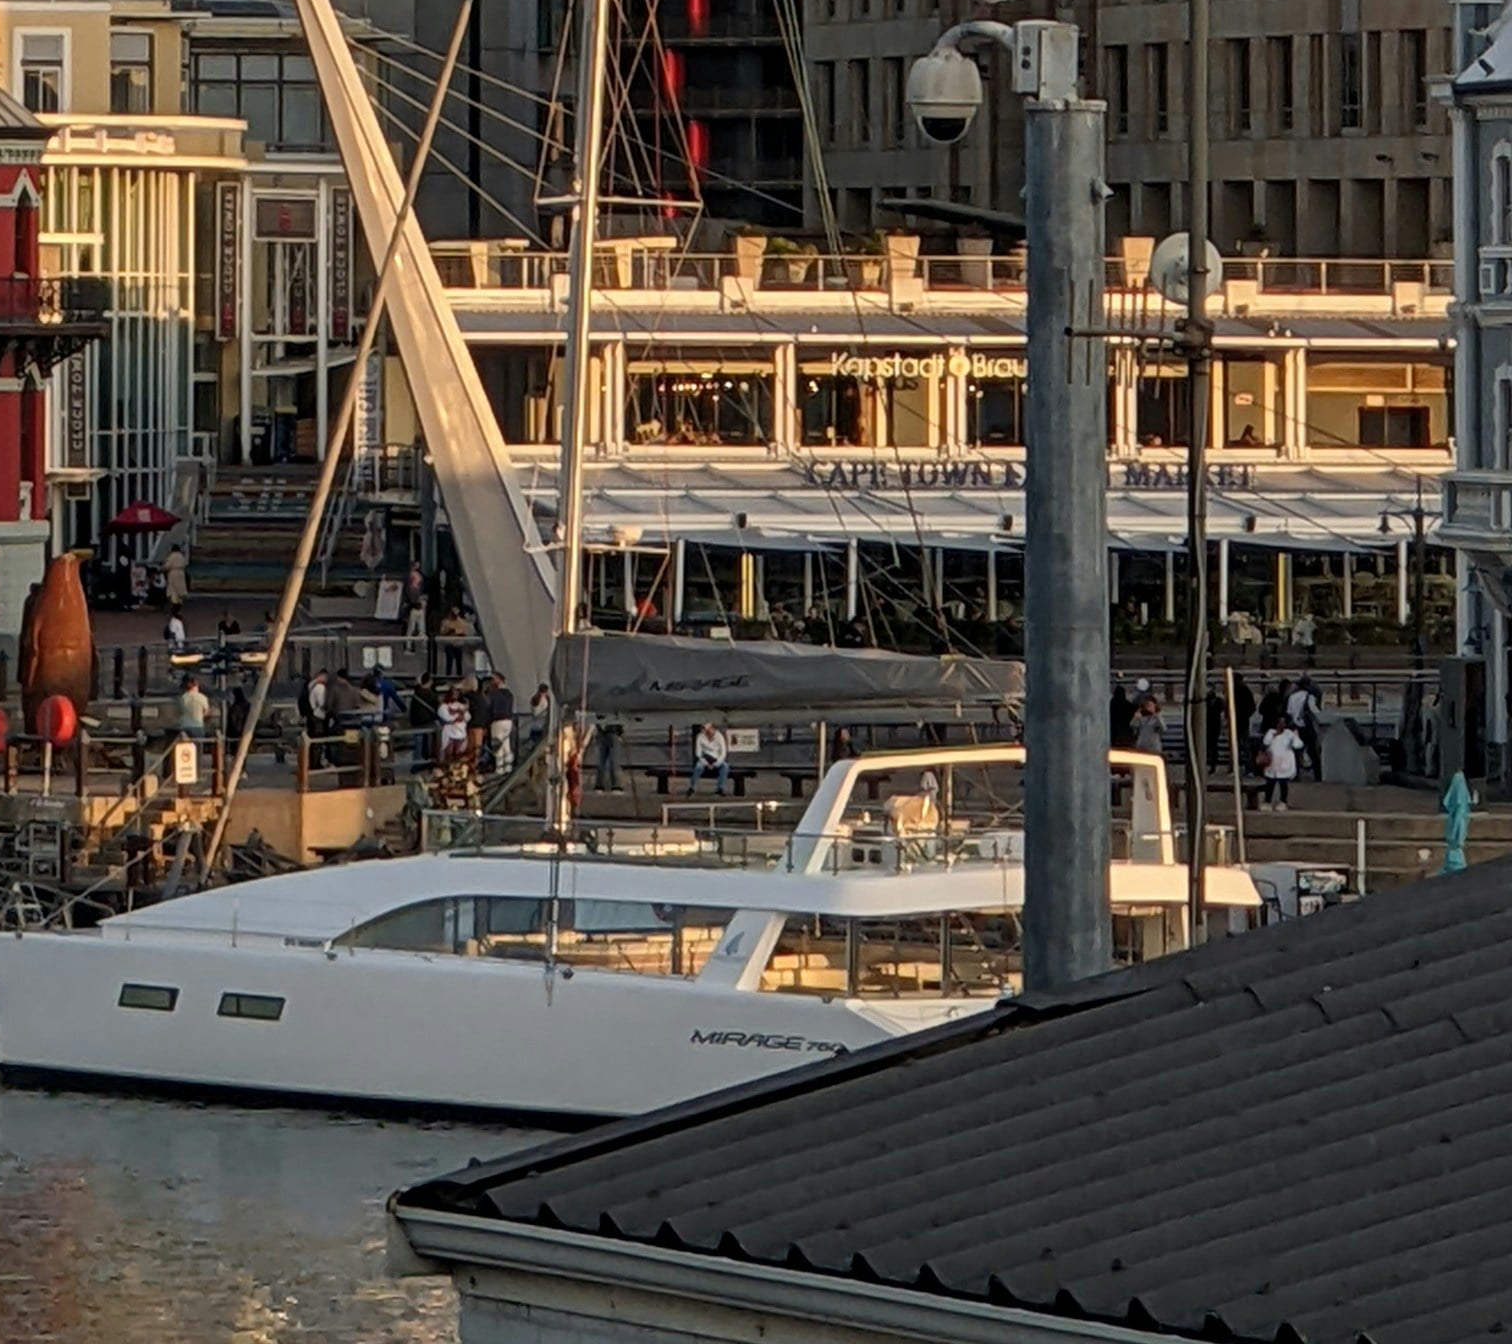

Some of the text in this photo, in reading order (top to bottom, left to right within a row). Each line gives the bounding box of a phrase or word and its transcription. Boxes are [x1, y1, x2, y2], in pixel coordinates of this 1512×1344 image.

[223, 191, 235, 243] TOWER
[223, 246, 235, 294] CLOCK
[335, 250, 347, 297] CLOCK
[830, 351, 1029, 381] Kapstadt Brau
[72, 353, 83, 449] CLOCK TOW
[805, 461, 886, 486] CAPE
[900, 461, 991, 486] TOWN
[690, 1029, 806, 1051] MIRAGE
